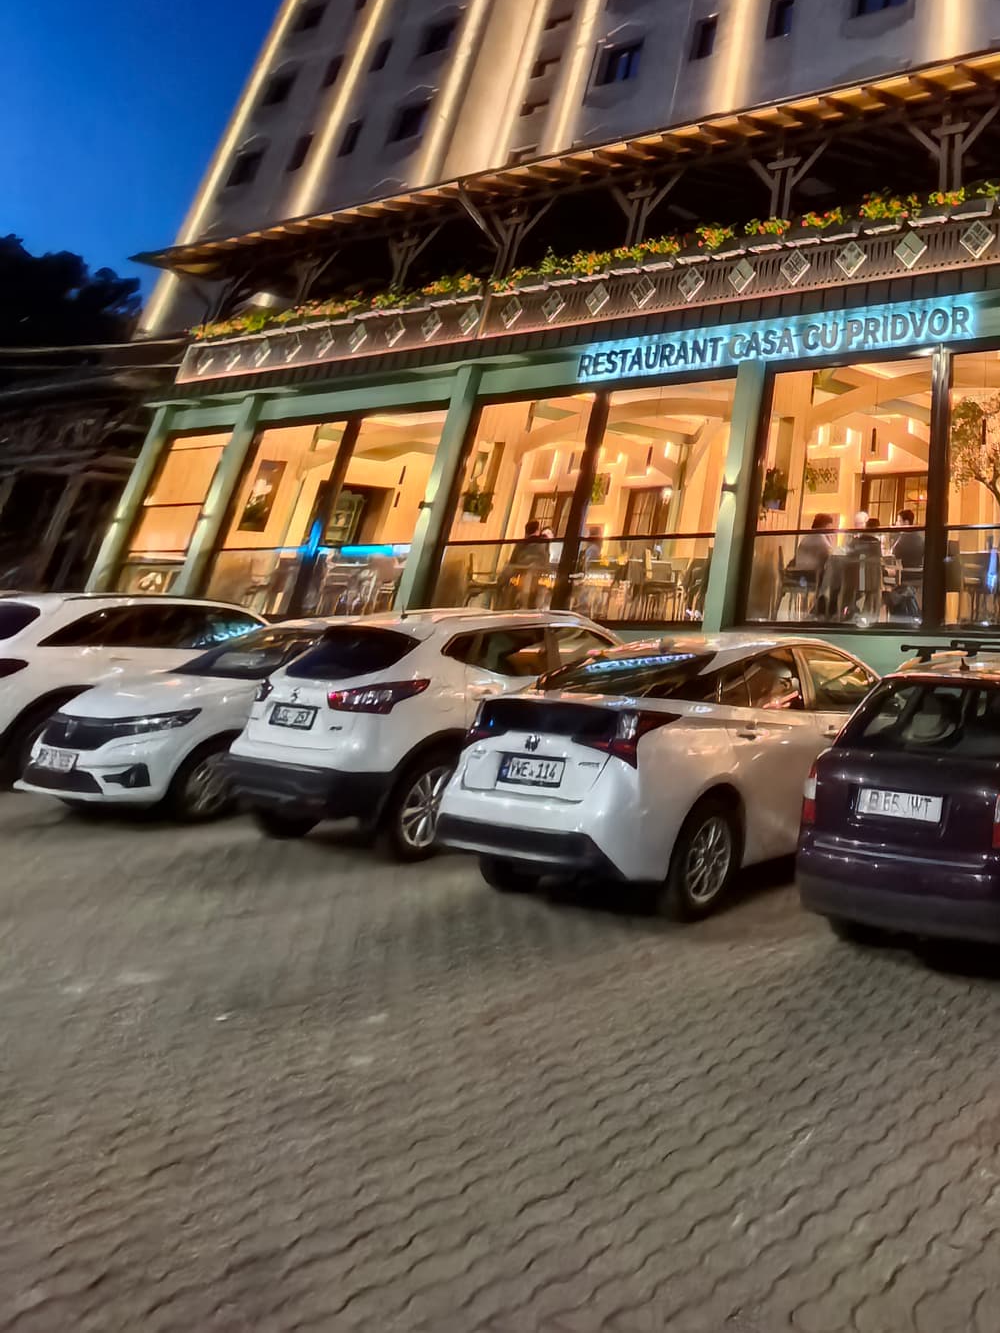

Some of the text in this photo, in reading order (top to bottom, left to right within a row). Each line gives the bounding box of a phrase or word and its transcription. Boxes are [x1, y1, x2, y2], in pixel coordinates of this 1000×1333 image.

[577, 306, 970, 378] RESTAURANT CASA CU PRIDVOR
